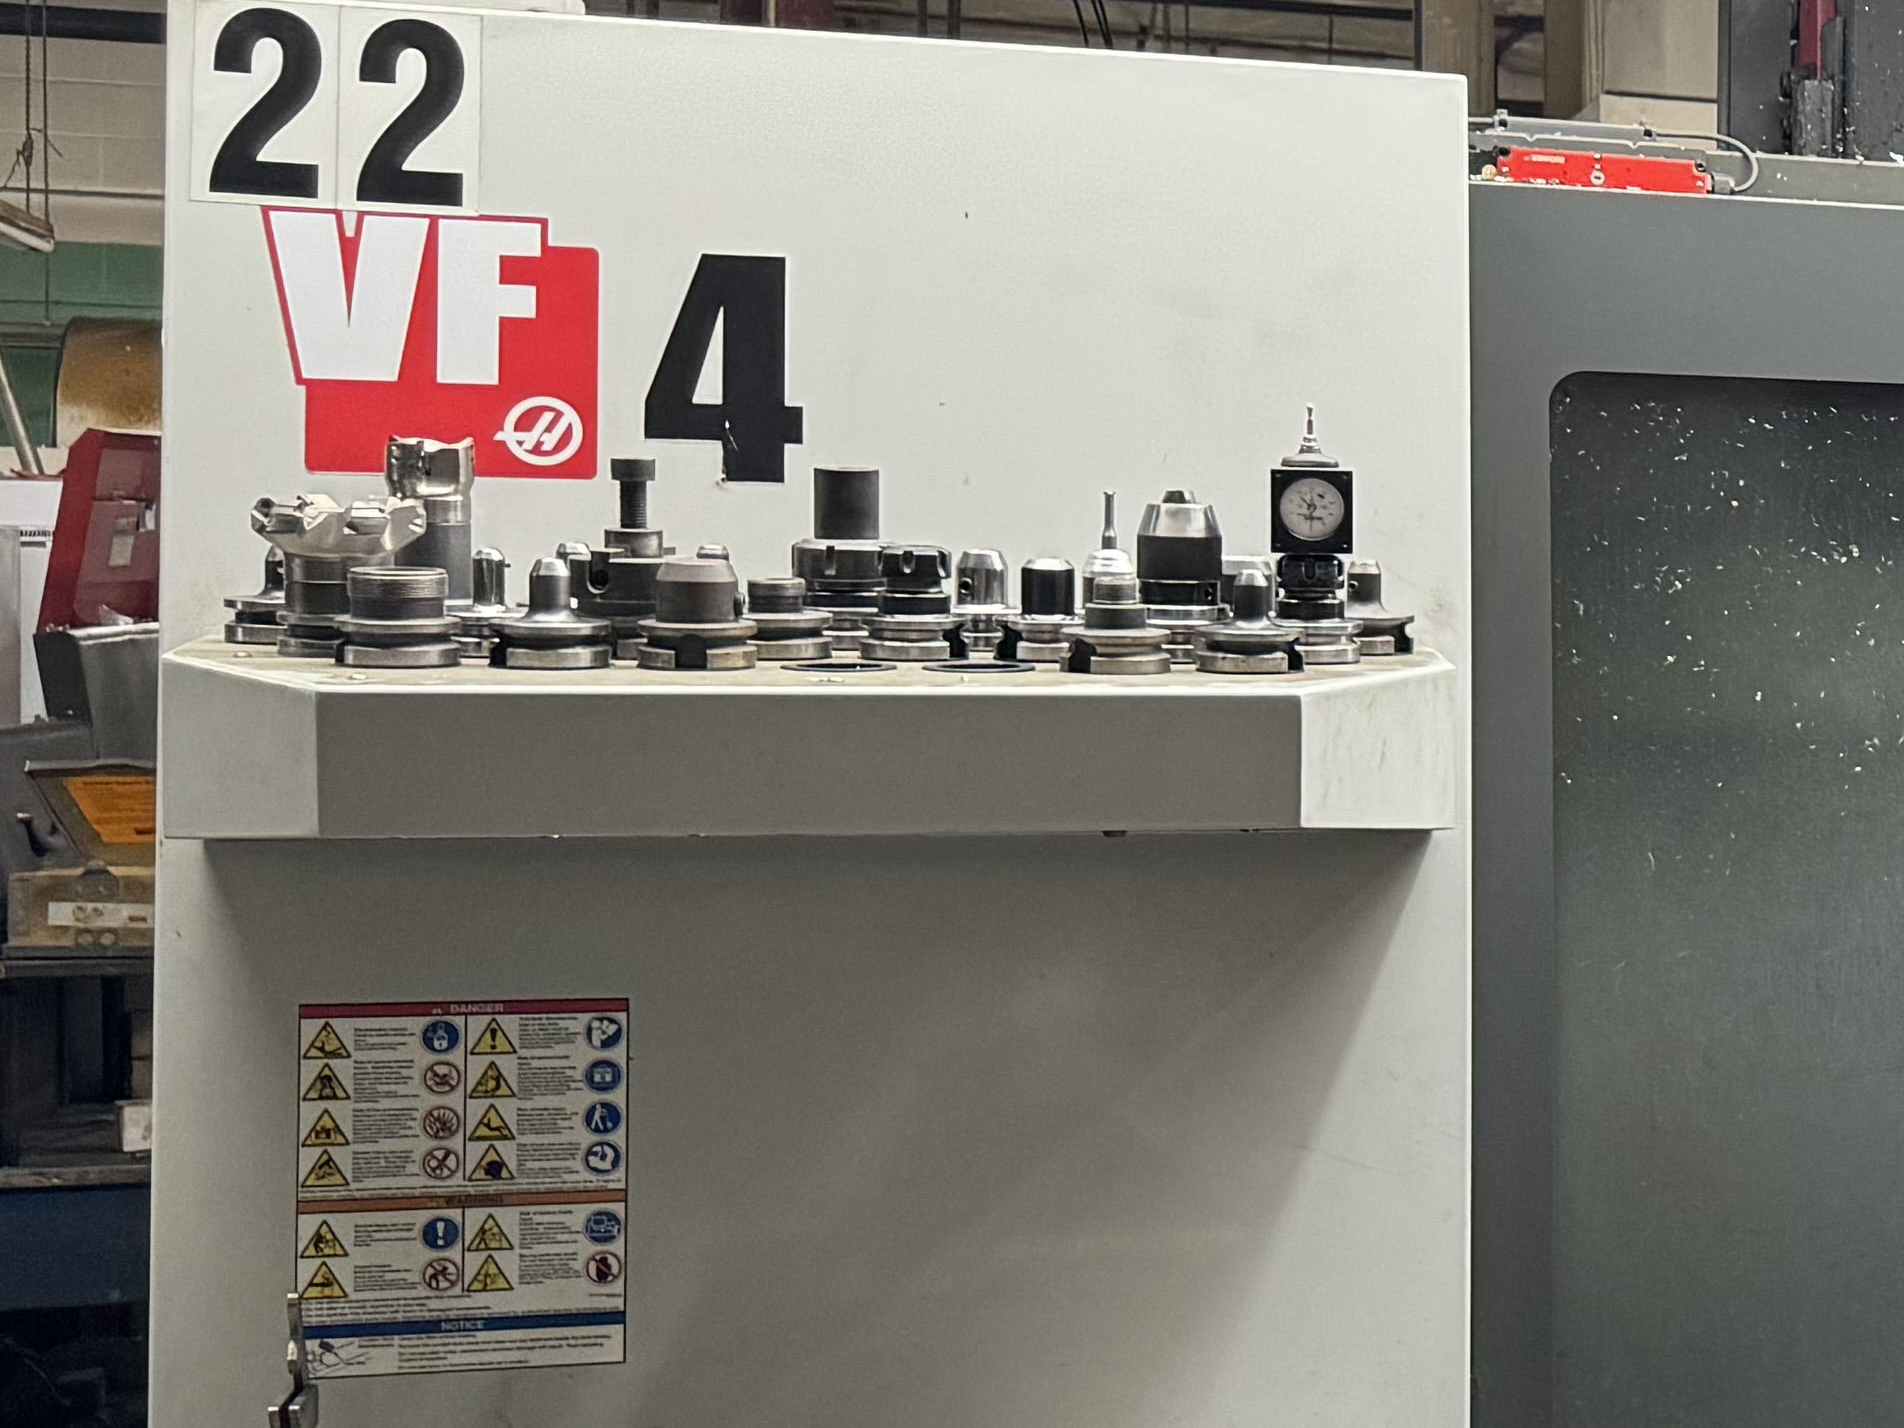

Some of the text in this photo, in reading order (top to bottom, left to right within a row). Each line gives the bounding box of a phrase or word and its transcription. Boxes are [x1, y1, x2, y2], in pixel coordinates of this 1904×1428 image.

[209, 6, 466, 206] 22
[266, 208, 804, 483] VF 4
[450, 1003, 504, 1014] DANGER
[441, 1320, 485, 1331] NOTICE
